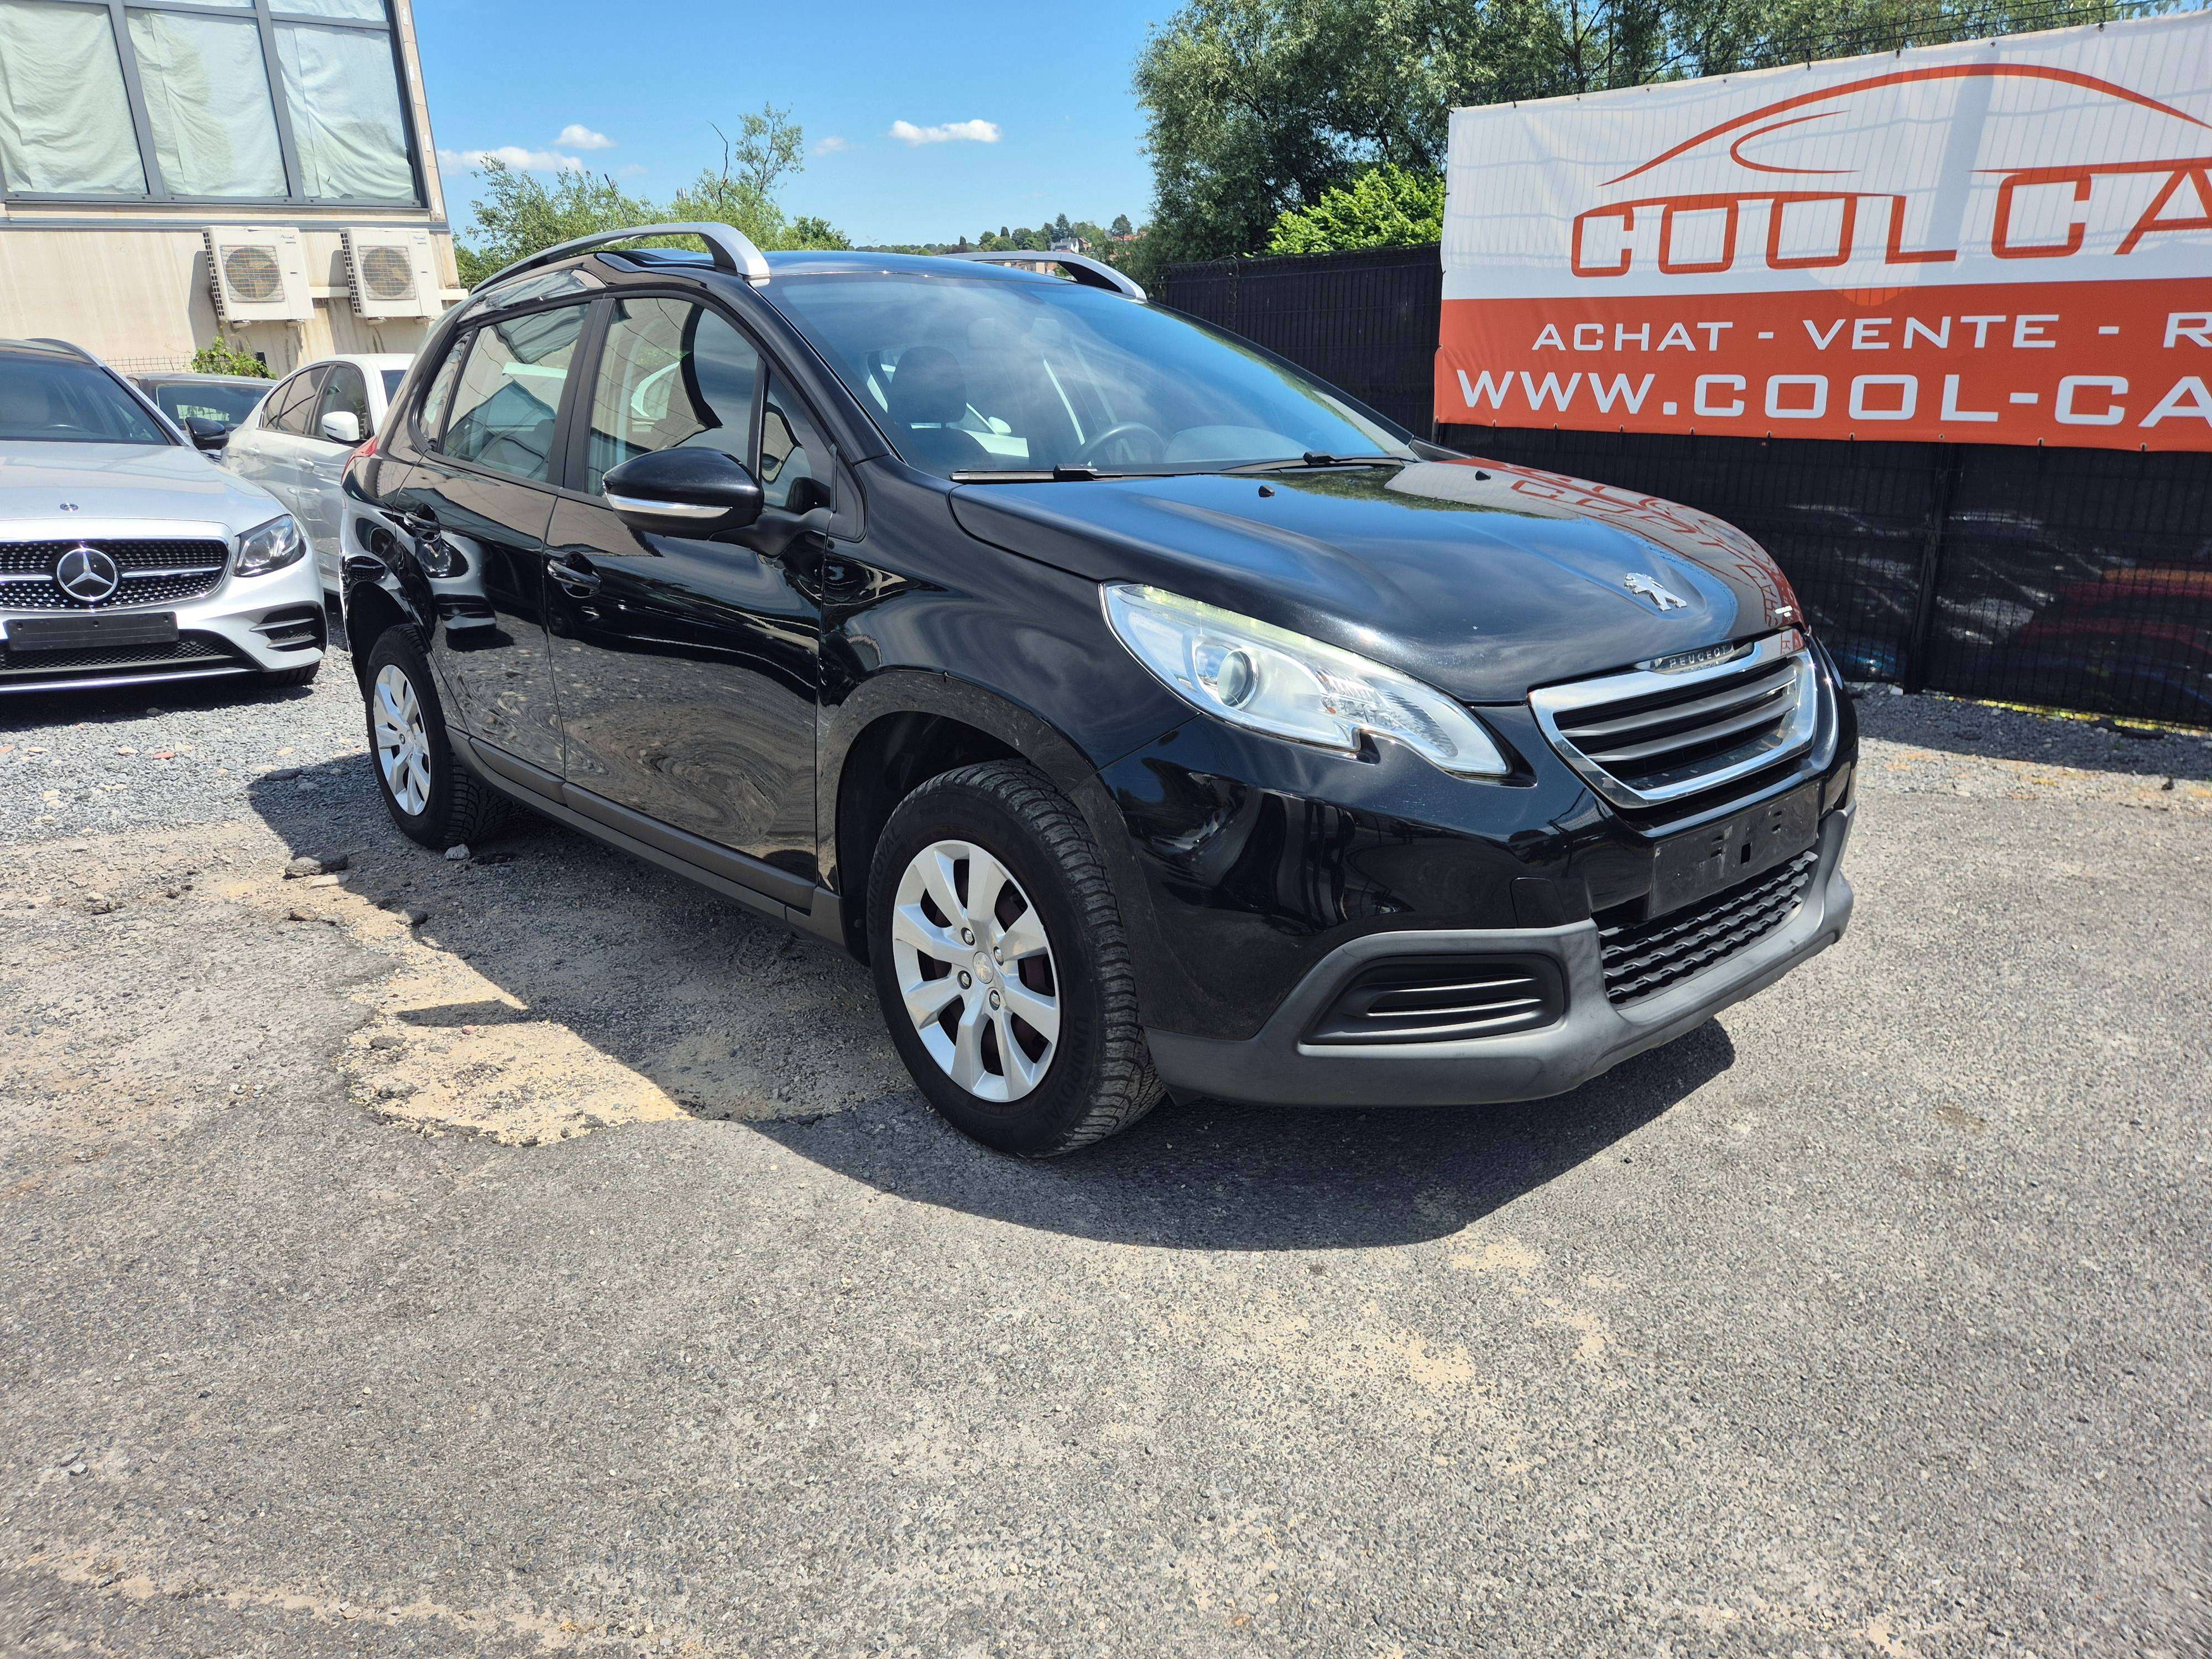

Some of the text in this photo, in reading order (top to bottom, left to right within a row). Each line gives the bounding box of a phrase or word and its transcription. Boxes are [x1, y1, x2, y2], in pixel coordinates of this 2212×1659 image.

[1571, 157, 2212, 278] COOL CA
[1531, 321, 1733, 351] ACHAT
[1802, 314, 2059, 350] VENTE
[2163, 311, 2212, 348] R
[1457, 369, 2212, 427] WWW.COOL-CA
[1669, 645, 1727, 669] PEUGEOT
